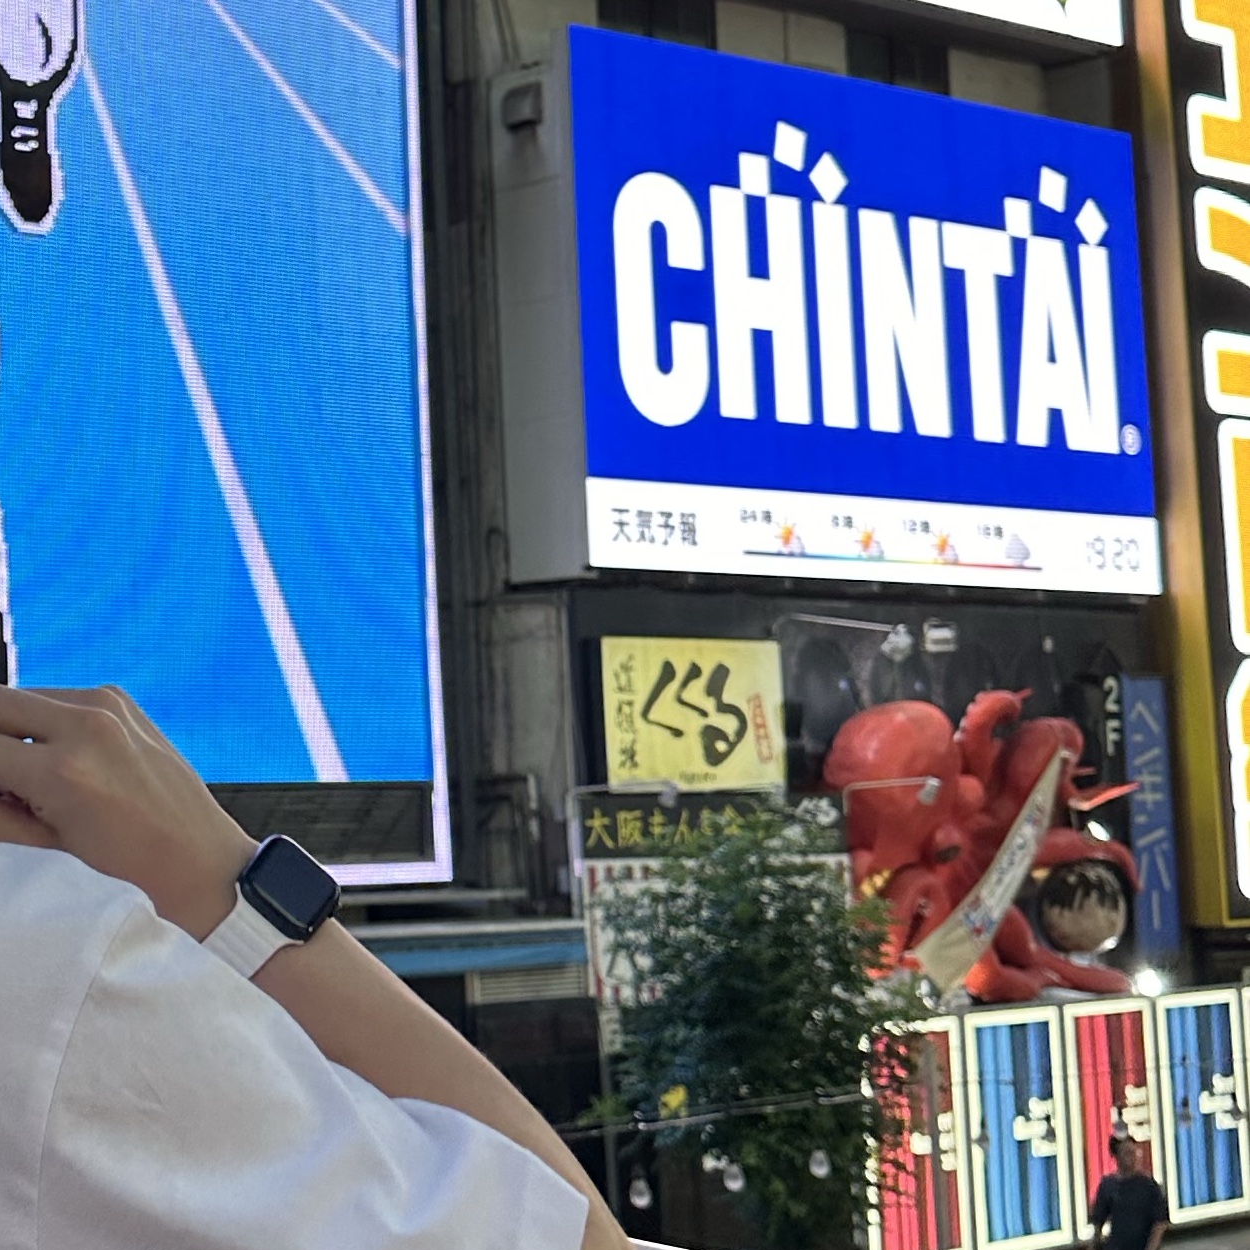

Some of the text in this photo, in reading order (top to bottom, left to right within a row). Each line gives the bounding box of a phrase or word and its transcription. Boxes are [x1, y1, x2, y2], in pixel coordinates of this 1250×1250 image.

[612, 120, 1121, 455] CHINTAI
[611, 508, 698, 546] 天気予報
[641, 659, 749, 768] くくる
